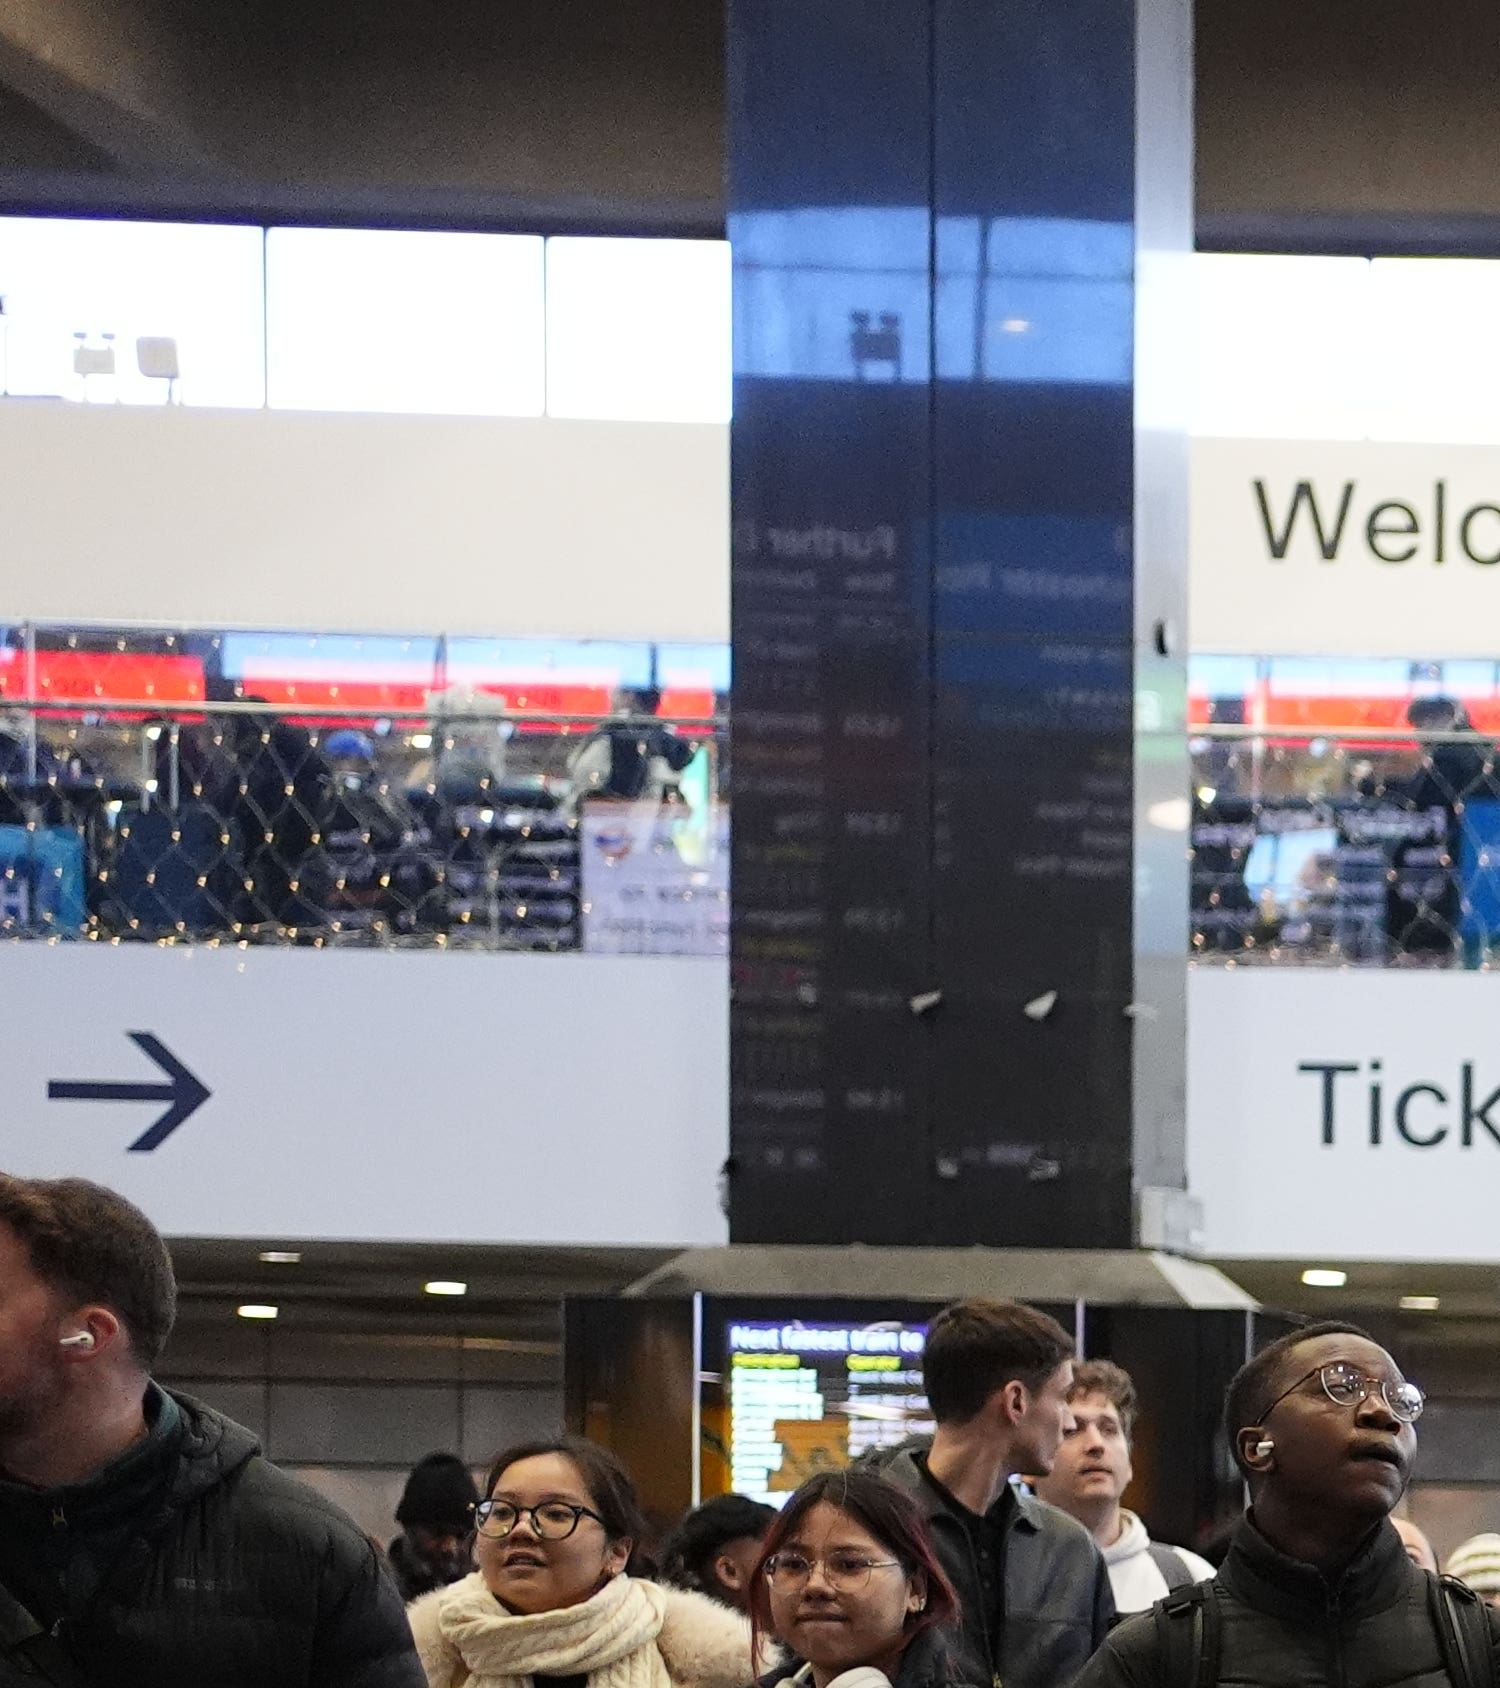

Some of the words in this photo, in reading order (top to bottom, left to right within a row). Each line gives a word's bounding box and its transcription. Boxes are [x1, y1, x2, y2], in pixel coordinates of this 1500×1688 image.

[731, 1325, 779, 1350] Next
[781, 1325, 848, 1351] fastest
[850, 1330, 898, 1352] train
[900, 1331, 925, 1353] to
